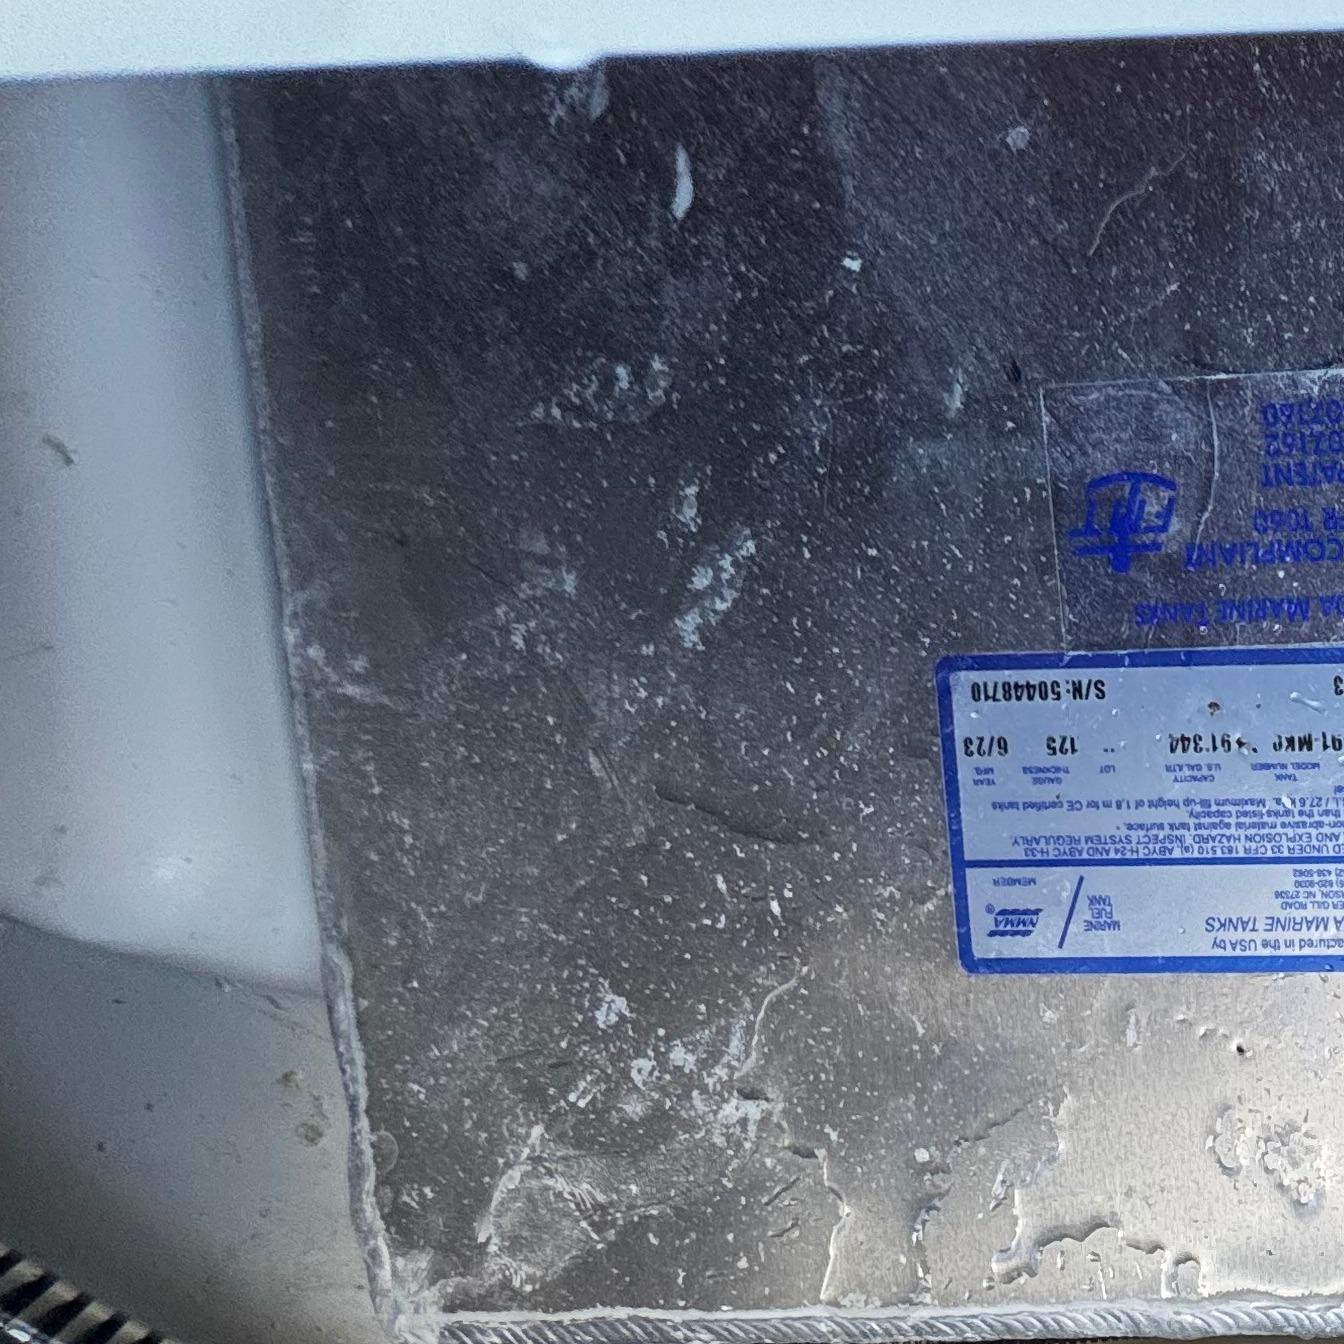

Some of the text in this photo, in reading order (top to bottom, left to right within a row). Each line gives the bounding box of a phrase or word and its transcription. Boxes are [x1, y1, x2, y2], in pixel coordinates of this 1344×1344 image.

[1184, 538, 1343, 569] COMPLIANT
[1134, 601, 1208, 628] TANKS
[1216, 597, 1310, 624] MARINE
[971, 679, 1106, 702] S/N: 50448710
[963, 736, 1008, 758] 6/23
[1022, 766, 1070, 774] THICKNESS
[1099, 765, 1115, 773] LOT
[1250, 762, 1320, 771] MODEL NUMBER
[972, 778, 996, 786] YEAR
[1173, 774, 1215, 783] CAPACITY
[992, 802, 1019, 812] tanks
[1023, 801, 1063, 811] certified
[1066, 801, 1083, 811] CE
[1086, 800, 1099, 810] for
[1102, 800, 1112, 808] m
[1135, 800, 1145, 810] of
[1147, 797, 1180, 809] height
[1214, 798, 1266, 809] Maximum
[1273, 798, 1296, 808] ka.
[1299, 797, 1322, 807] 27.6
[1186, 809, 1232, 820] capacity.
[1298, 809, 1314, 818] the
[1318, 809, 1340, 818] than
[1168, 822, 1190, 831] tank
[1194, 820, 1232, 831] against
[1235, 821, 1277, 831] material
[1085, 835, 1131, 845] SYSTEM
[1134, 834, 1186, 844] INSPECT
[1244, 833, 1312, 843] EXPLOSION
[1316, 832, 1341, 842] AND
[1052, 847, 1084, 857] ABYC
[1087, 847, 1111, 856] AND
[1114, 846, 1139, 856] H-24
[1143, 846, 1174, 856] ABYC
[1243, 845, 1267, 854] CFR
[1271, 845, 1284, 854] 33
[1287, 844, 1329, 854] UNDER
[992, 877, 1037, 886] MEMBER
[1087, 895, 1112, 907] TANK
[1281, 901, 1307, 910] ROAD
[1089, 907, 1113, 919] FUEL
[994, 917, 1039, 928] NMMA
[1083, 920, 1120, 931] MARINE
[1204, 916, 1258, 933] TANKS
[1264, 916, 1329, 932] MARINE
[1211, 936, 1226, 952] by
[1230, 938, 1257, 952] USA
[1261, 938, 1280, 952] the
[1284, 938, 1295, 951] in
